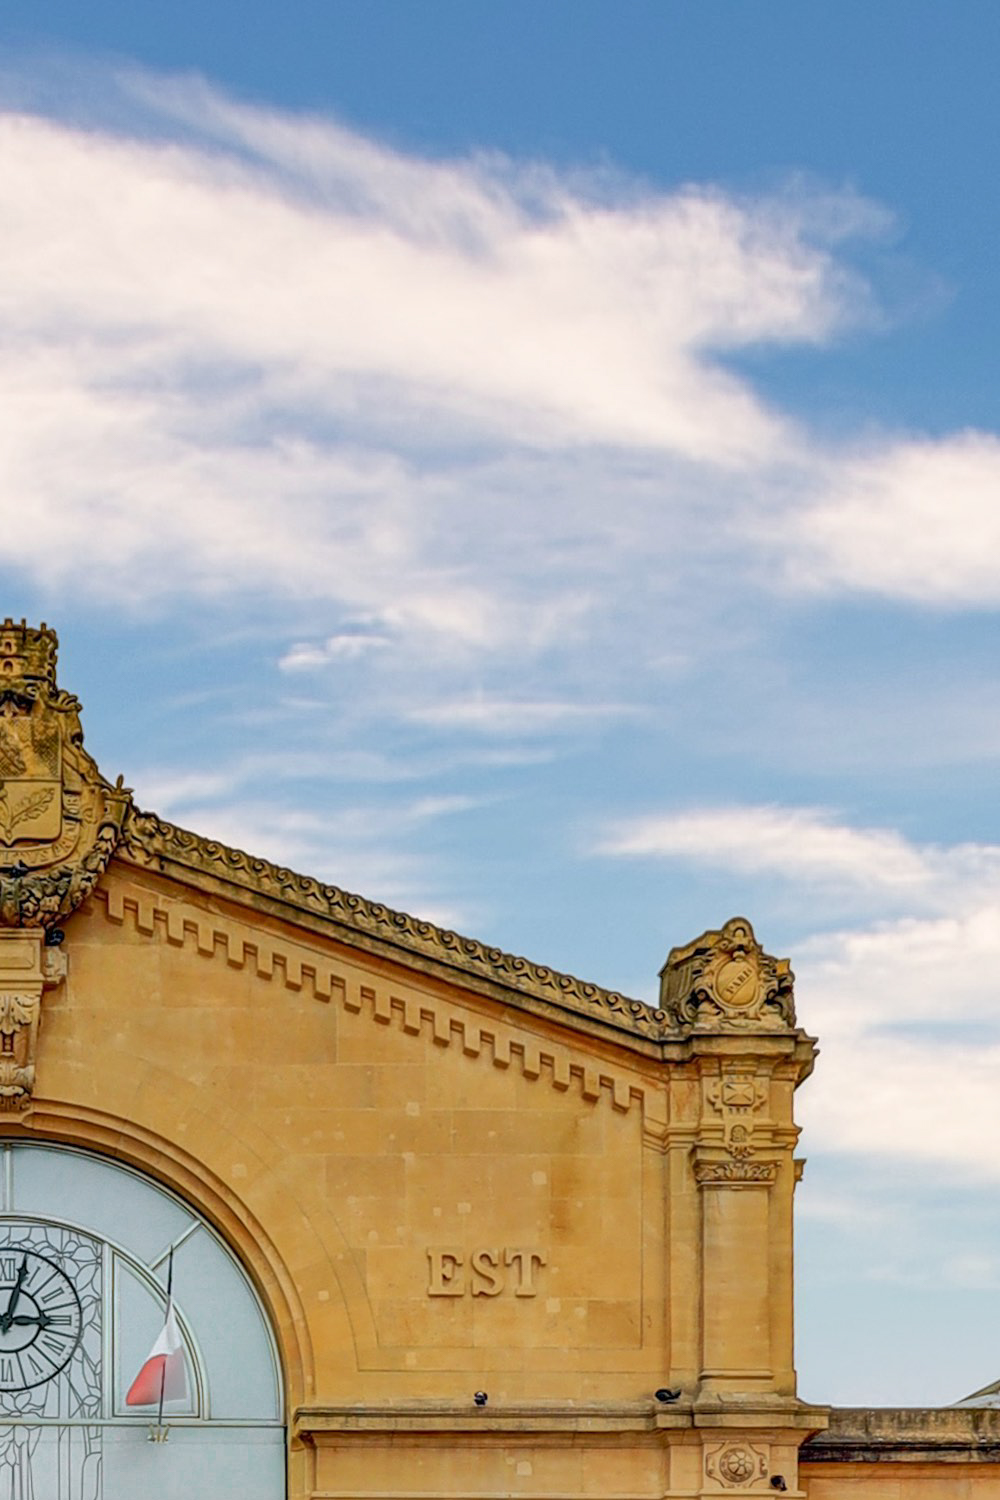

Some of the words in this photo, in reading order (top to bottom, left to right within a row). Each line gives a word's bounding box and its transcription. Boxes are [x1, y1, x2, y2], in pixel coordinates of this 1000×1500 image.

[0, 1258, 16, 1281] XII
[426, 1246, 548, 1298] EST
[41, 1286, 65, 1304] II
